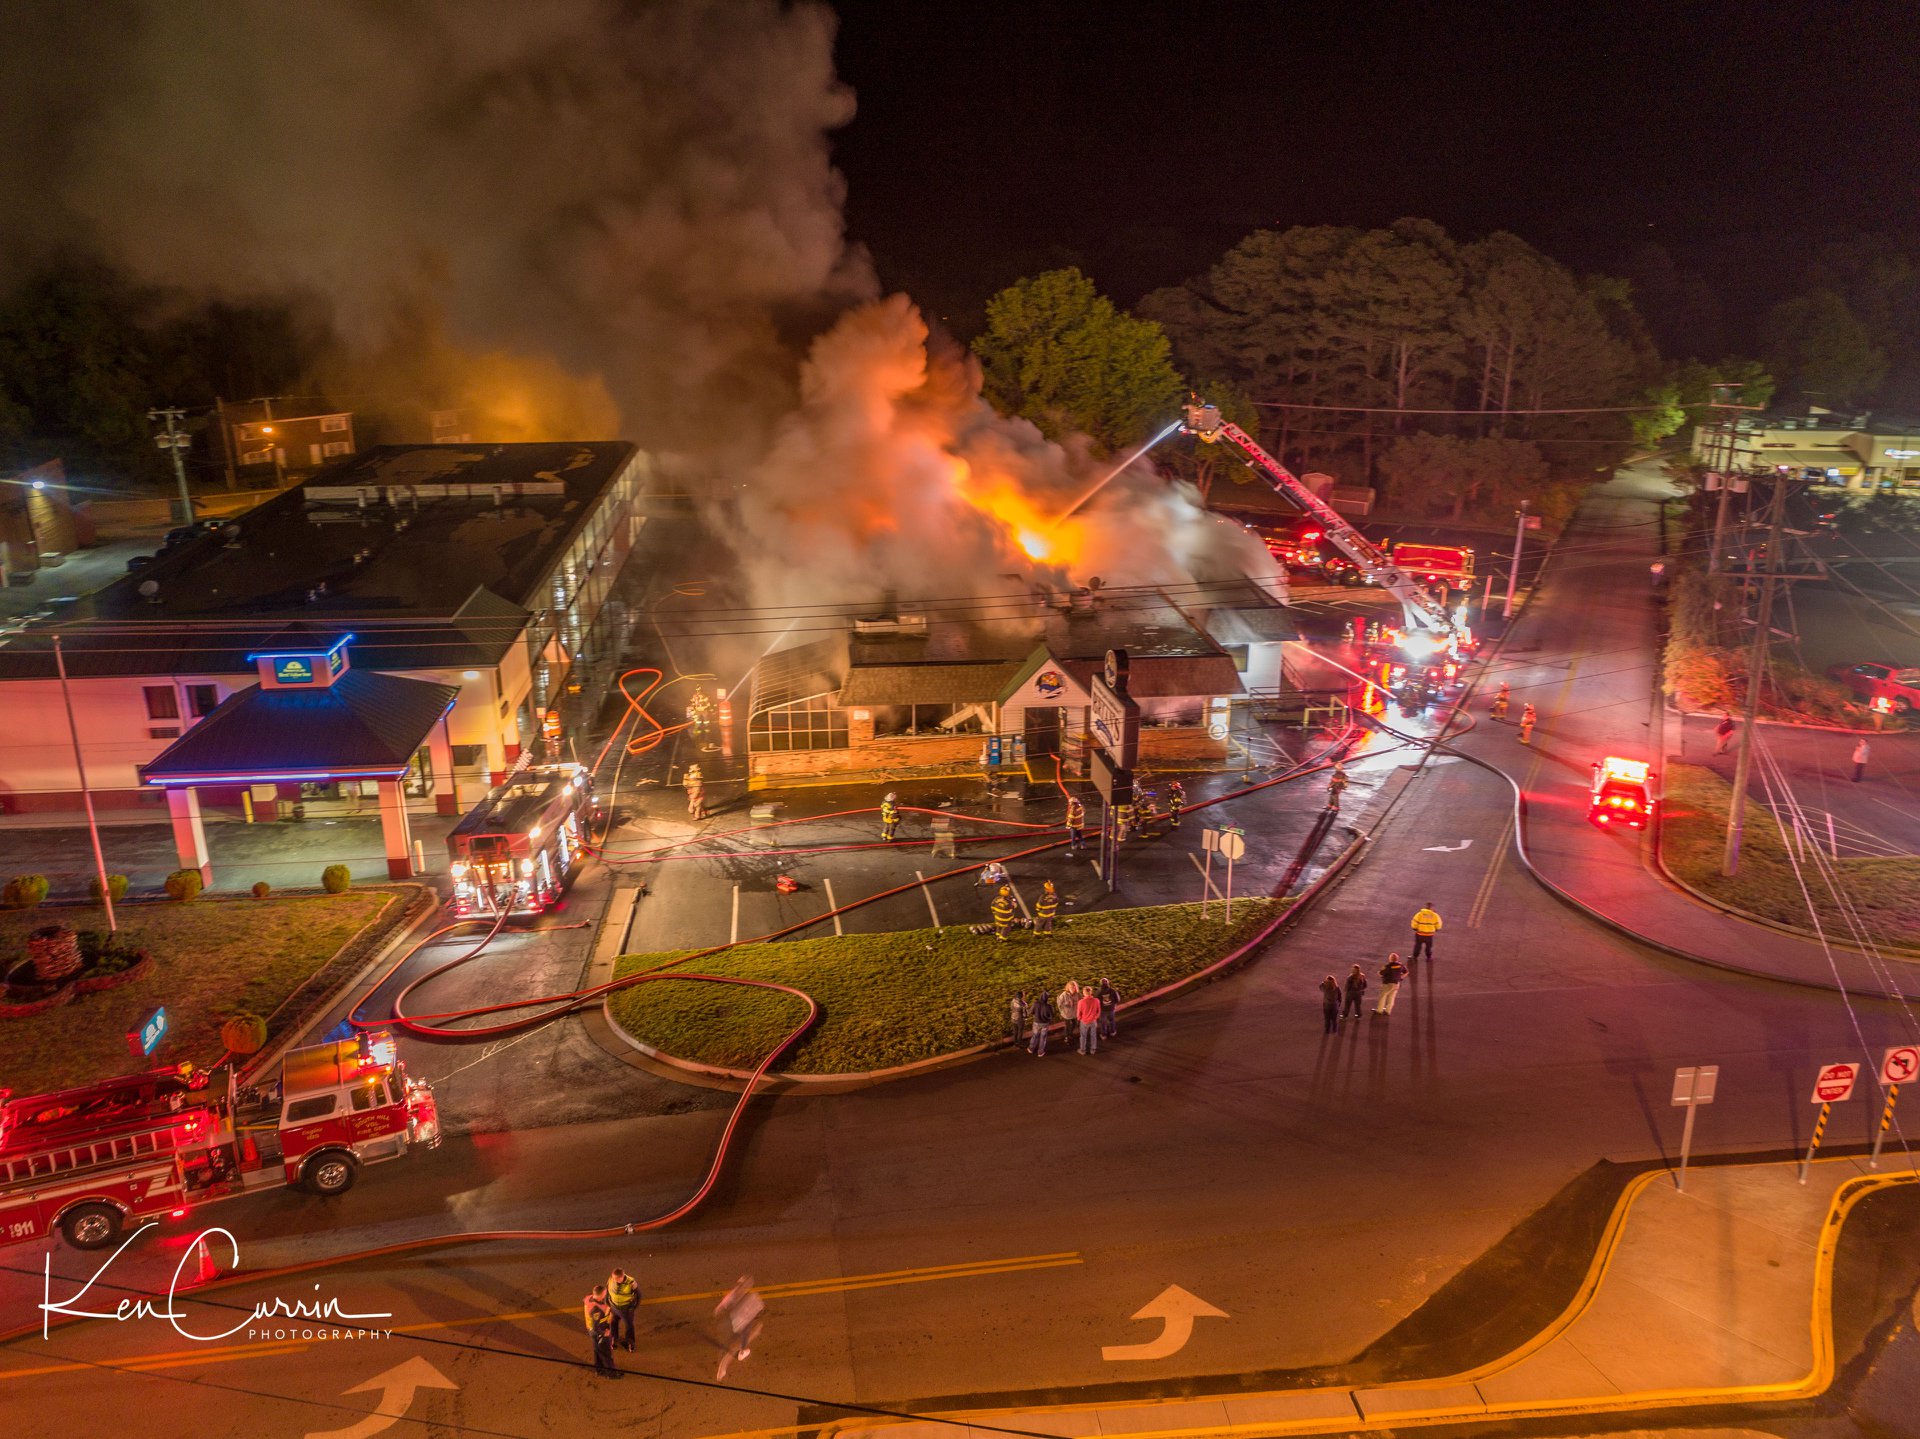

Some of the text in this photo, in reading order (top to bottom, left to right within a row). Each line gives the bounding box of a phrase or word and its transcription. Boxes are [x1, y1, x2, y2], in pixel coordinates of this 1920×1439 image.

[1822, 1070, 1851, 1080] DO NOT
[1820, 1086, 1844, 1096] ENTER
[14, 1219, 35, 1238] 911
